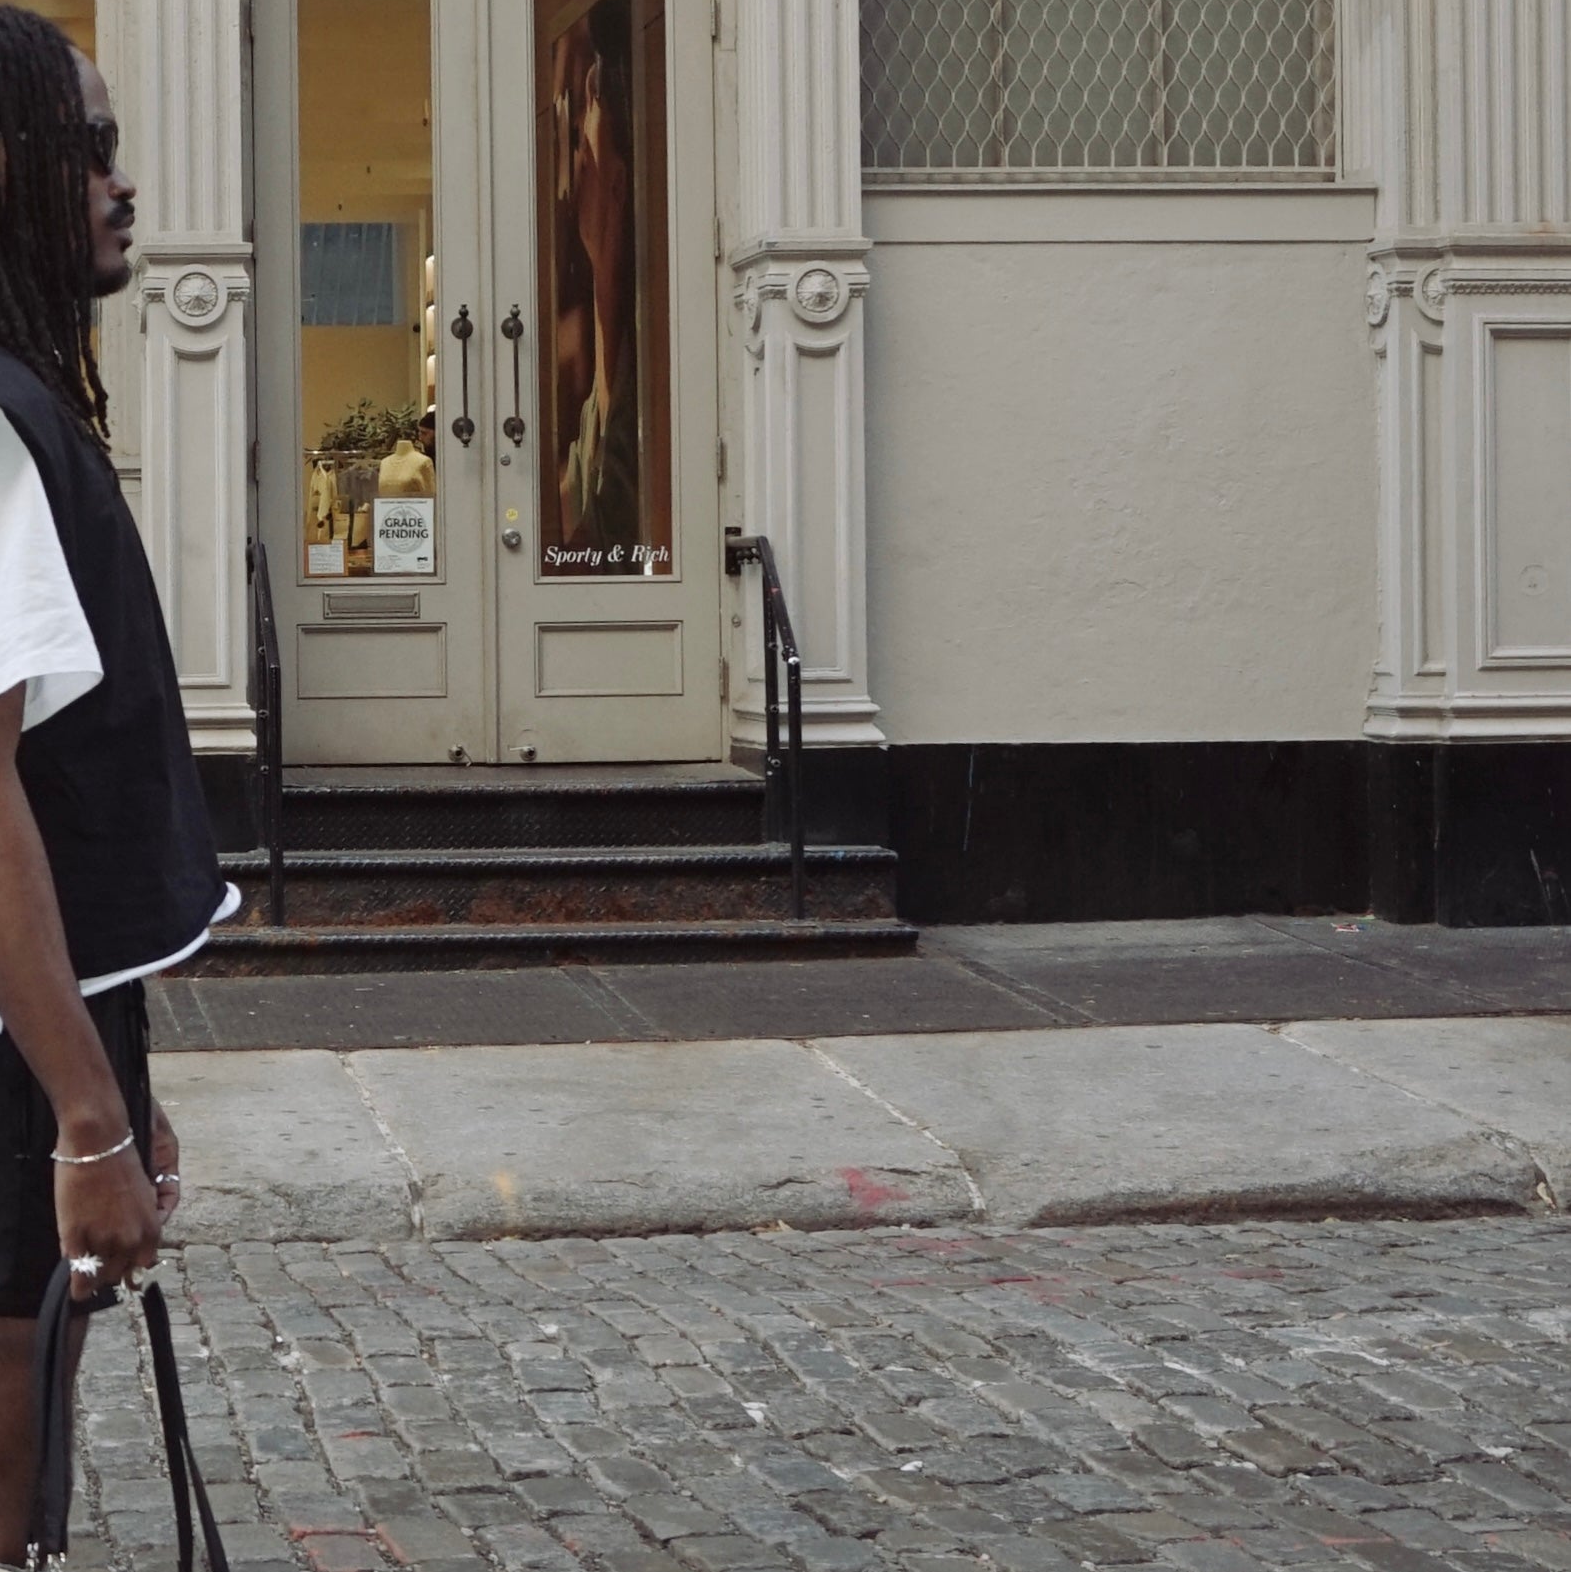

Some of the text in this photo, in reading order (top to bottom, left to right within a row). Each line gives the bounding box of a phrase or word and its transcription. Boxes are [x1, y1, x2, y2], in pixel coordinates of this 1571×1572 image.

[385, 517, 423, 528] GRADE
[379, 529, 429, 539] PENDING
[544, 544, 671, 567] Sporty & Rich
